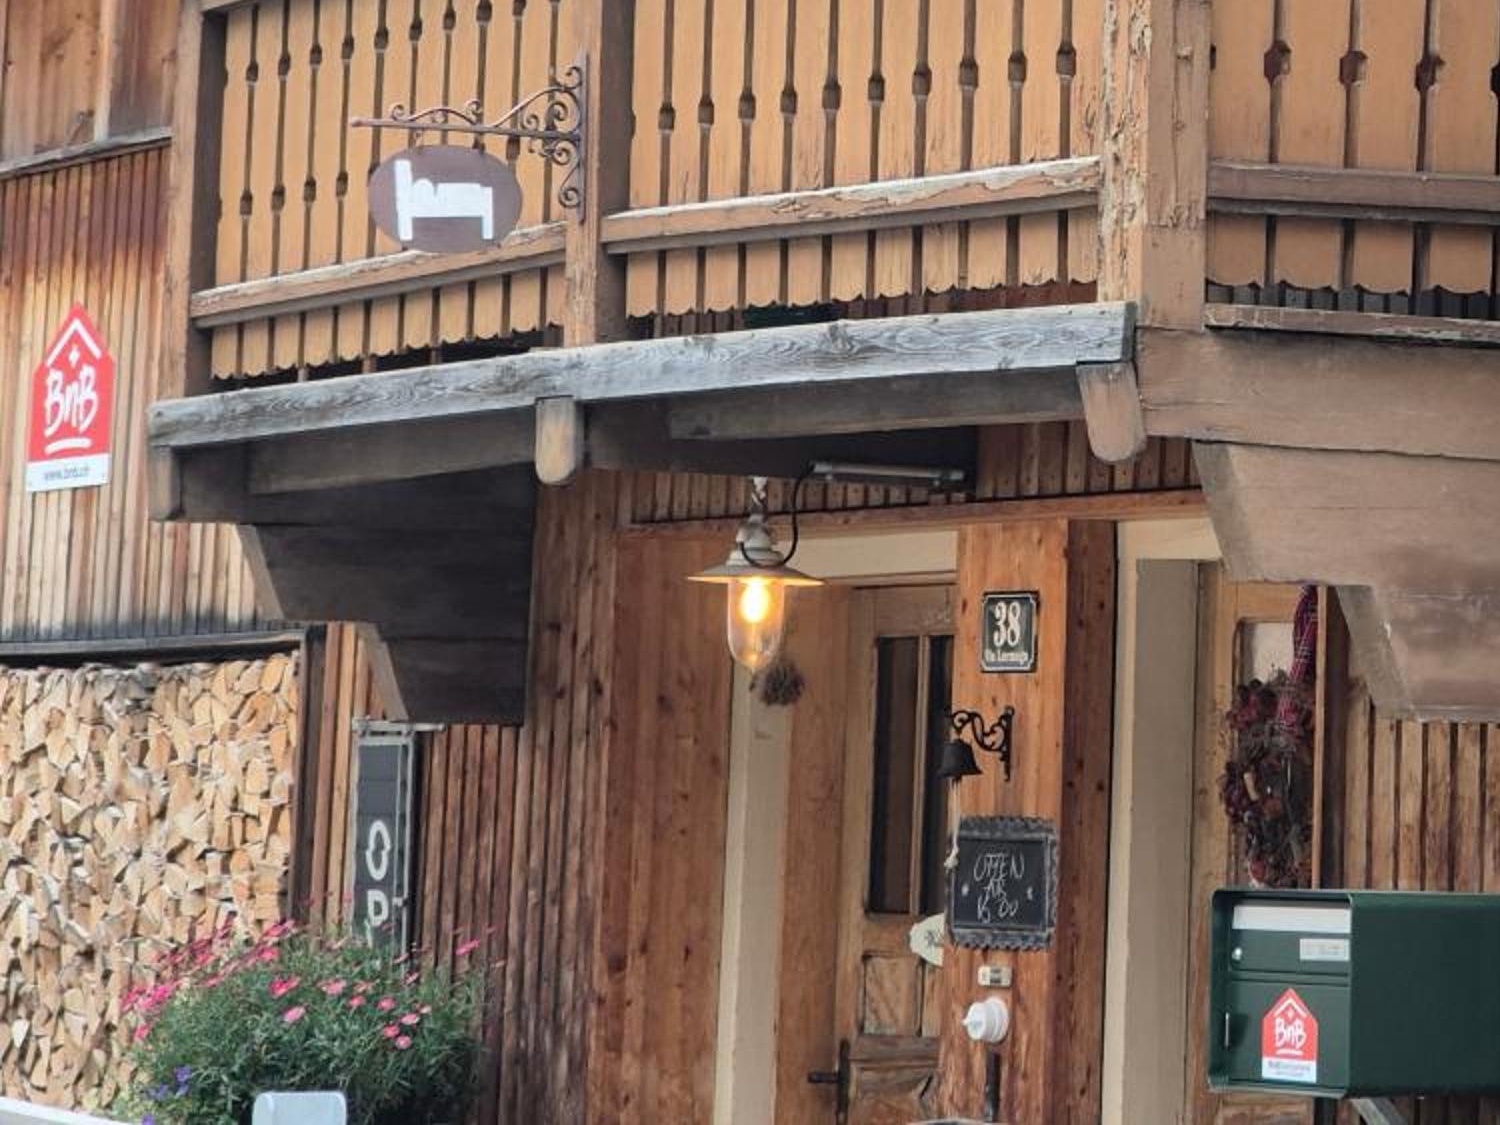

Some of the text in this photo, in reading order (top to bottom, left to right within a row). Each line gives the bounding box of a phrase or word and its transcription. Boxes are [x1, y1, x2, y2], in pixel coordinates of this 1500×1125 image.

[44, 364, 99, 437] BnB
[993, 601, 1021, 648] 38
[1274, 1017, 1307, 1049] BnB
